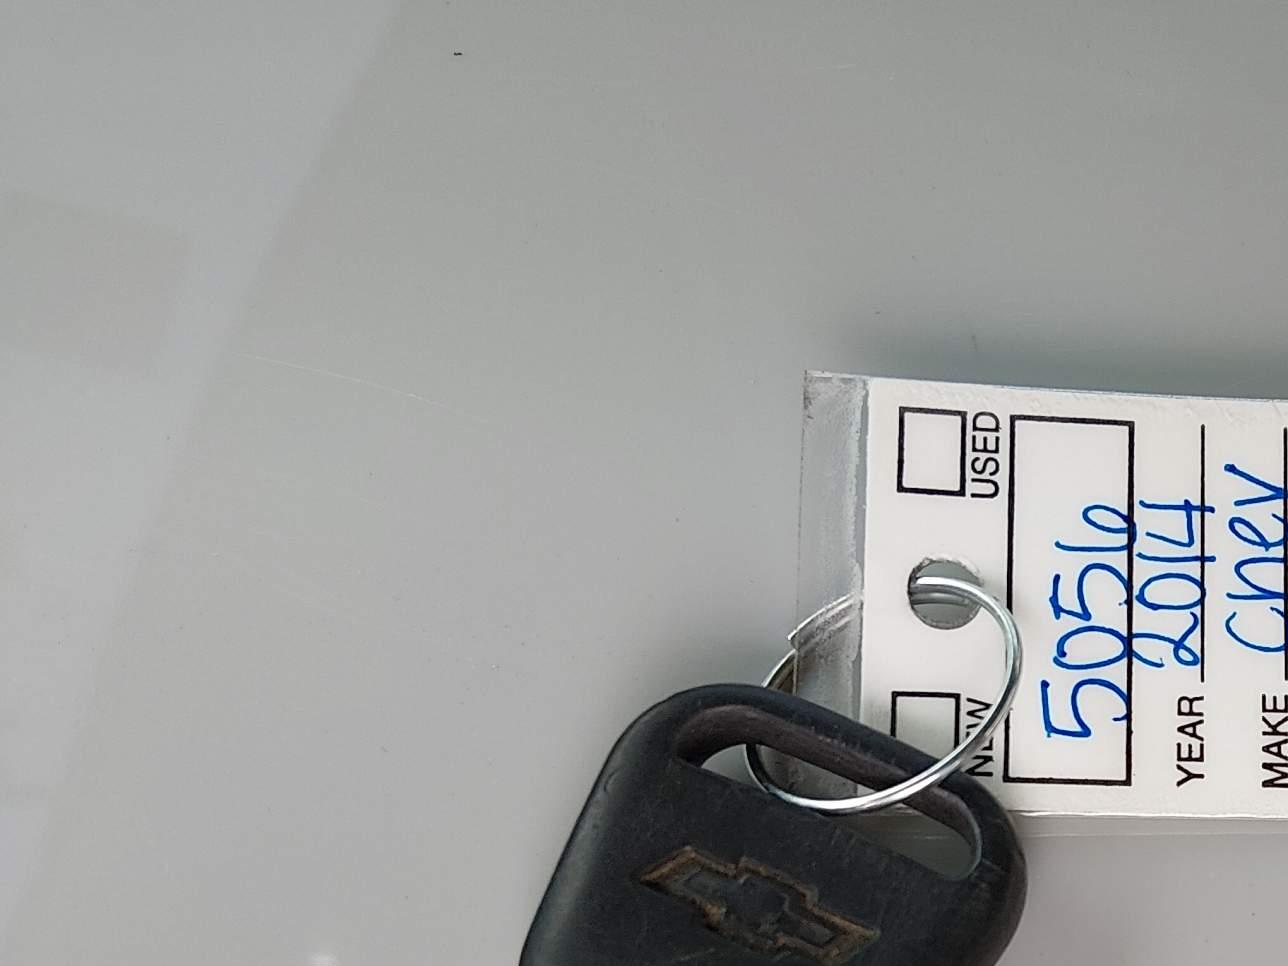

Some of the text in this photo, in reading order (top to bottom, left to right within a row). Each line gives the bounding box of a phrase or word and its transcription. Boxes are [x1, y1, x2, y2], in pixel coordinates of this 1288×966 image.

[970, 411, 1001, 499] USED
[1039, 502, 1137, 740] 5056
[1129, 498, 1217, 669] 2014
[1175, 694, 1206, 788] YEAR
